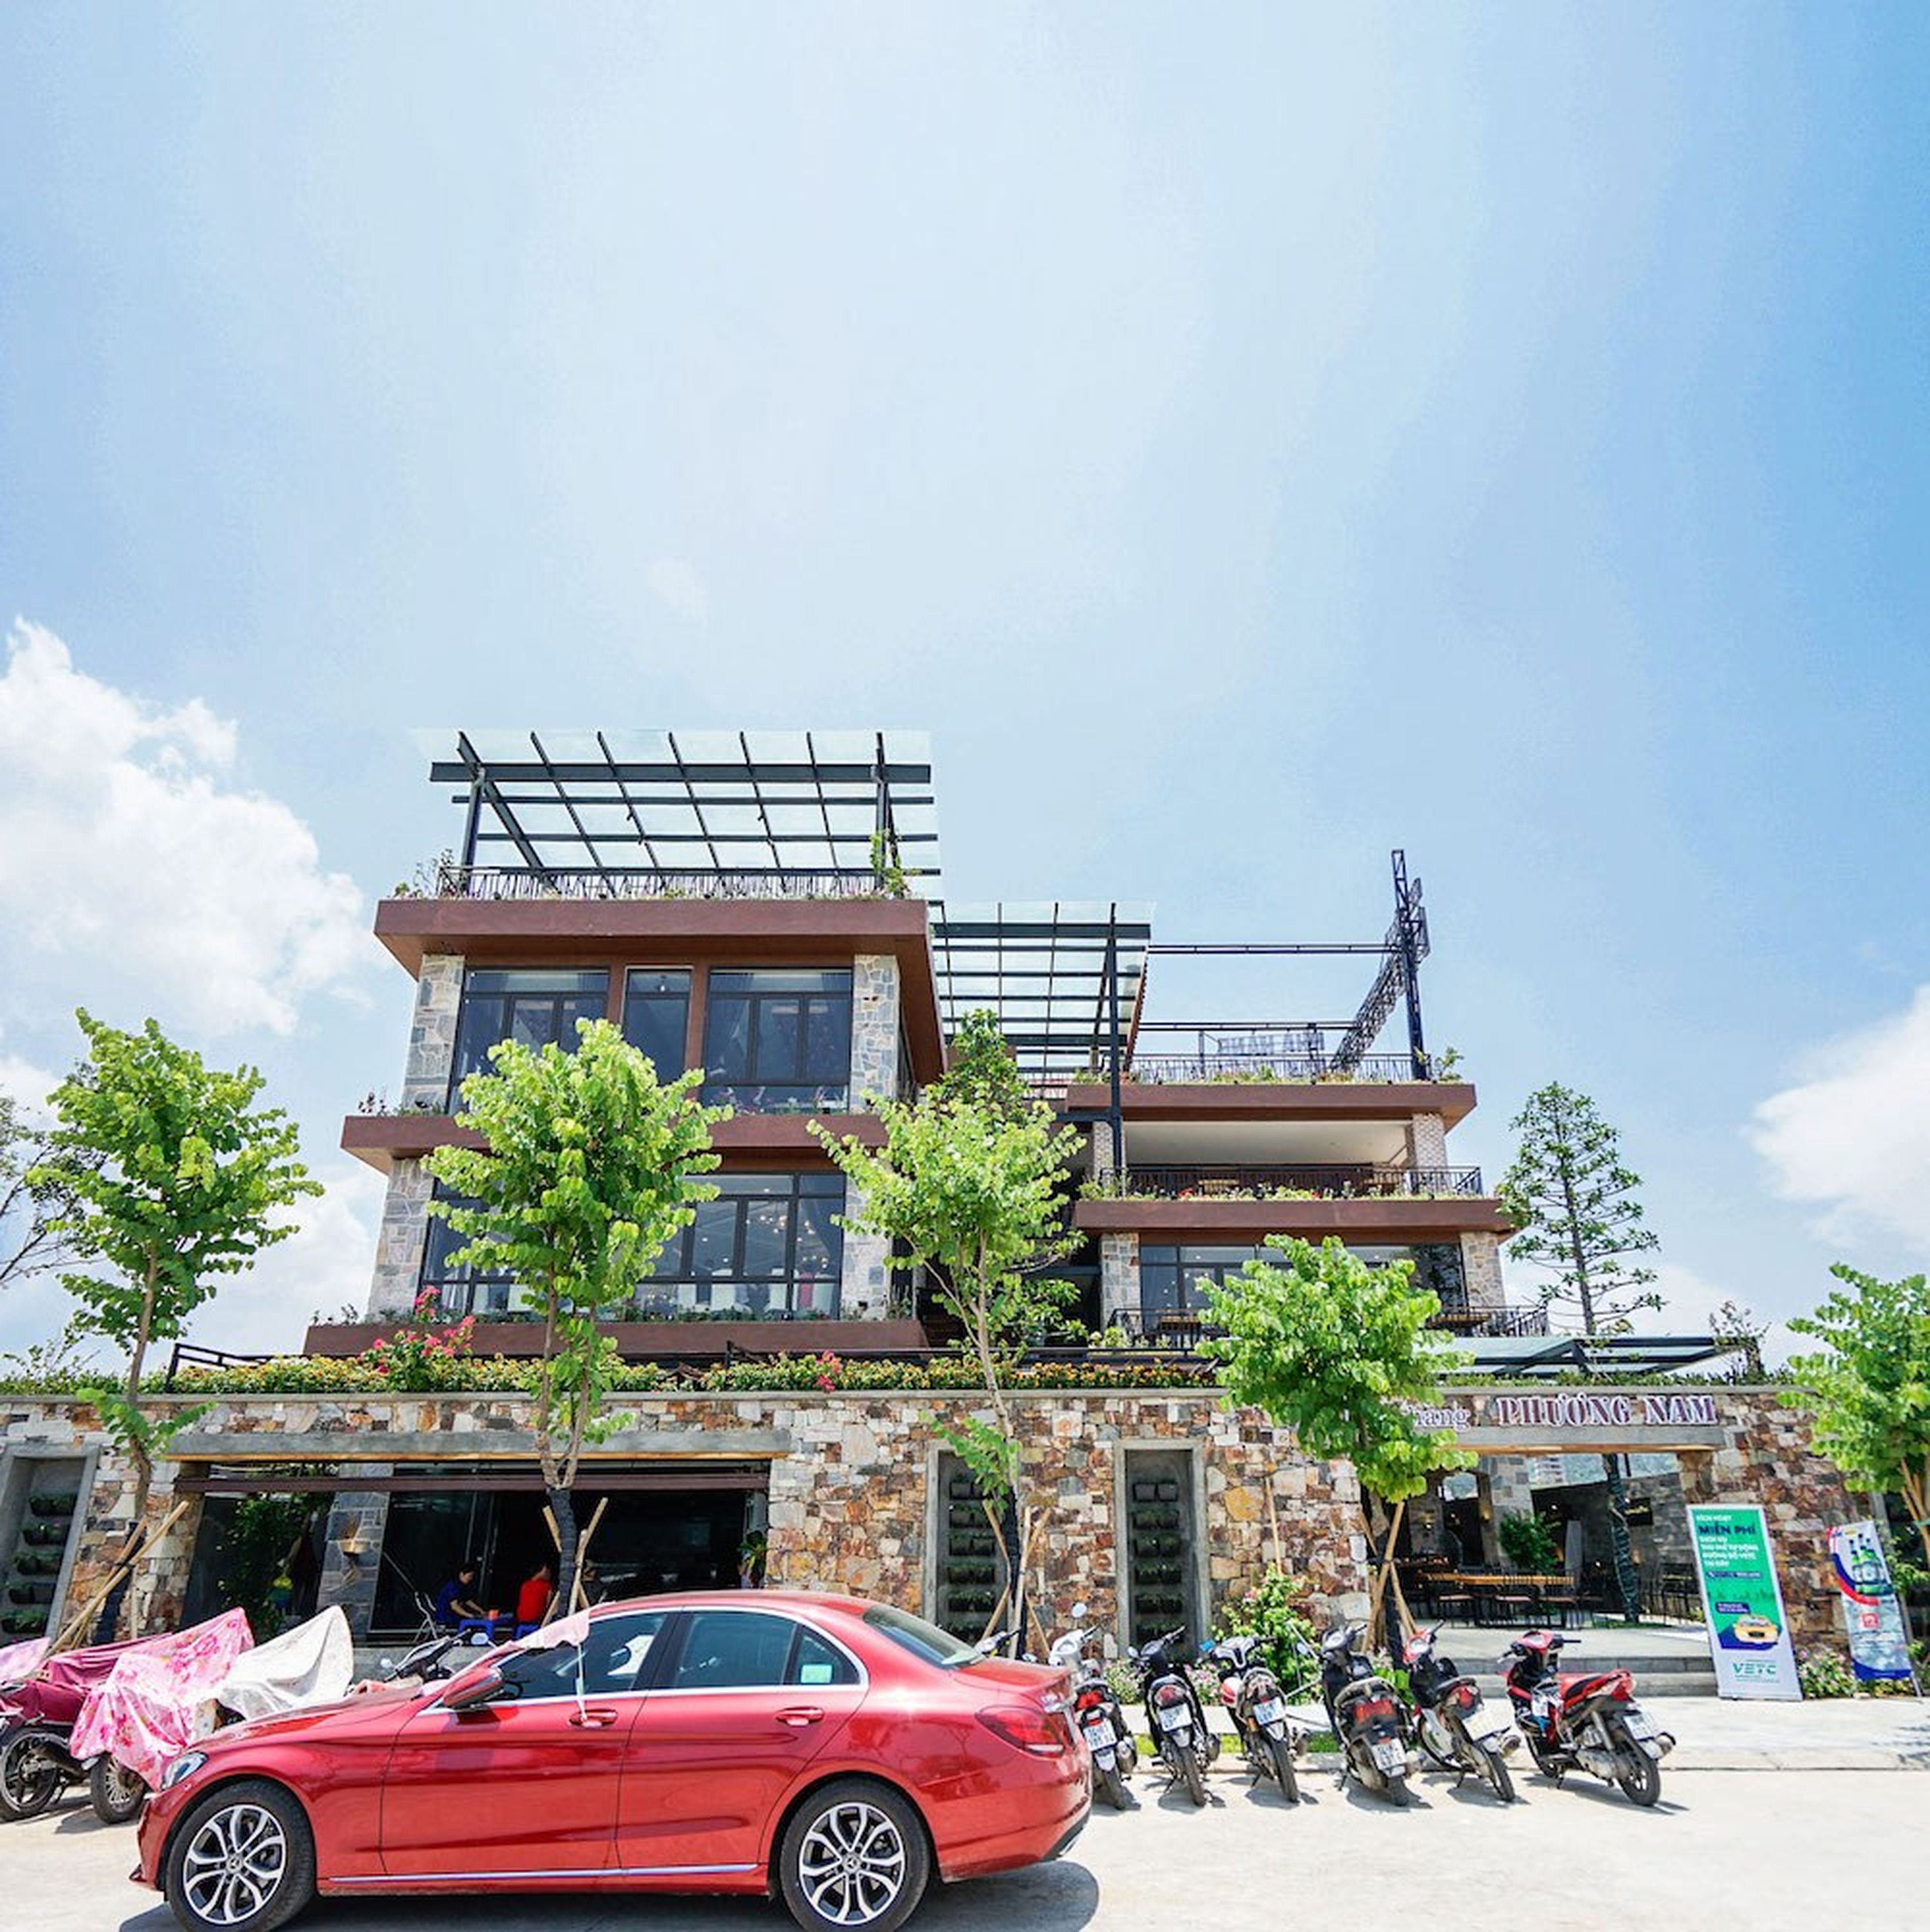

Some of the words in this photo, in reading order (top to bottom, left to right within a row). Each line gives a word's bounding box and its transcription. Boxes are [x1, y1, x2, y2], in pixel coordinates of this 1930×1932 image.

[1496, 1393, 1630, 1426] PHƯƠNG
[1643, 1395, 1718, 1424] NAM
[1733, 1663, 1776, 1674] VETC
